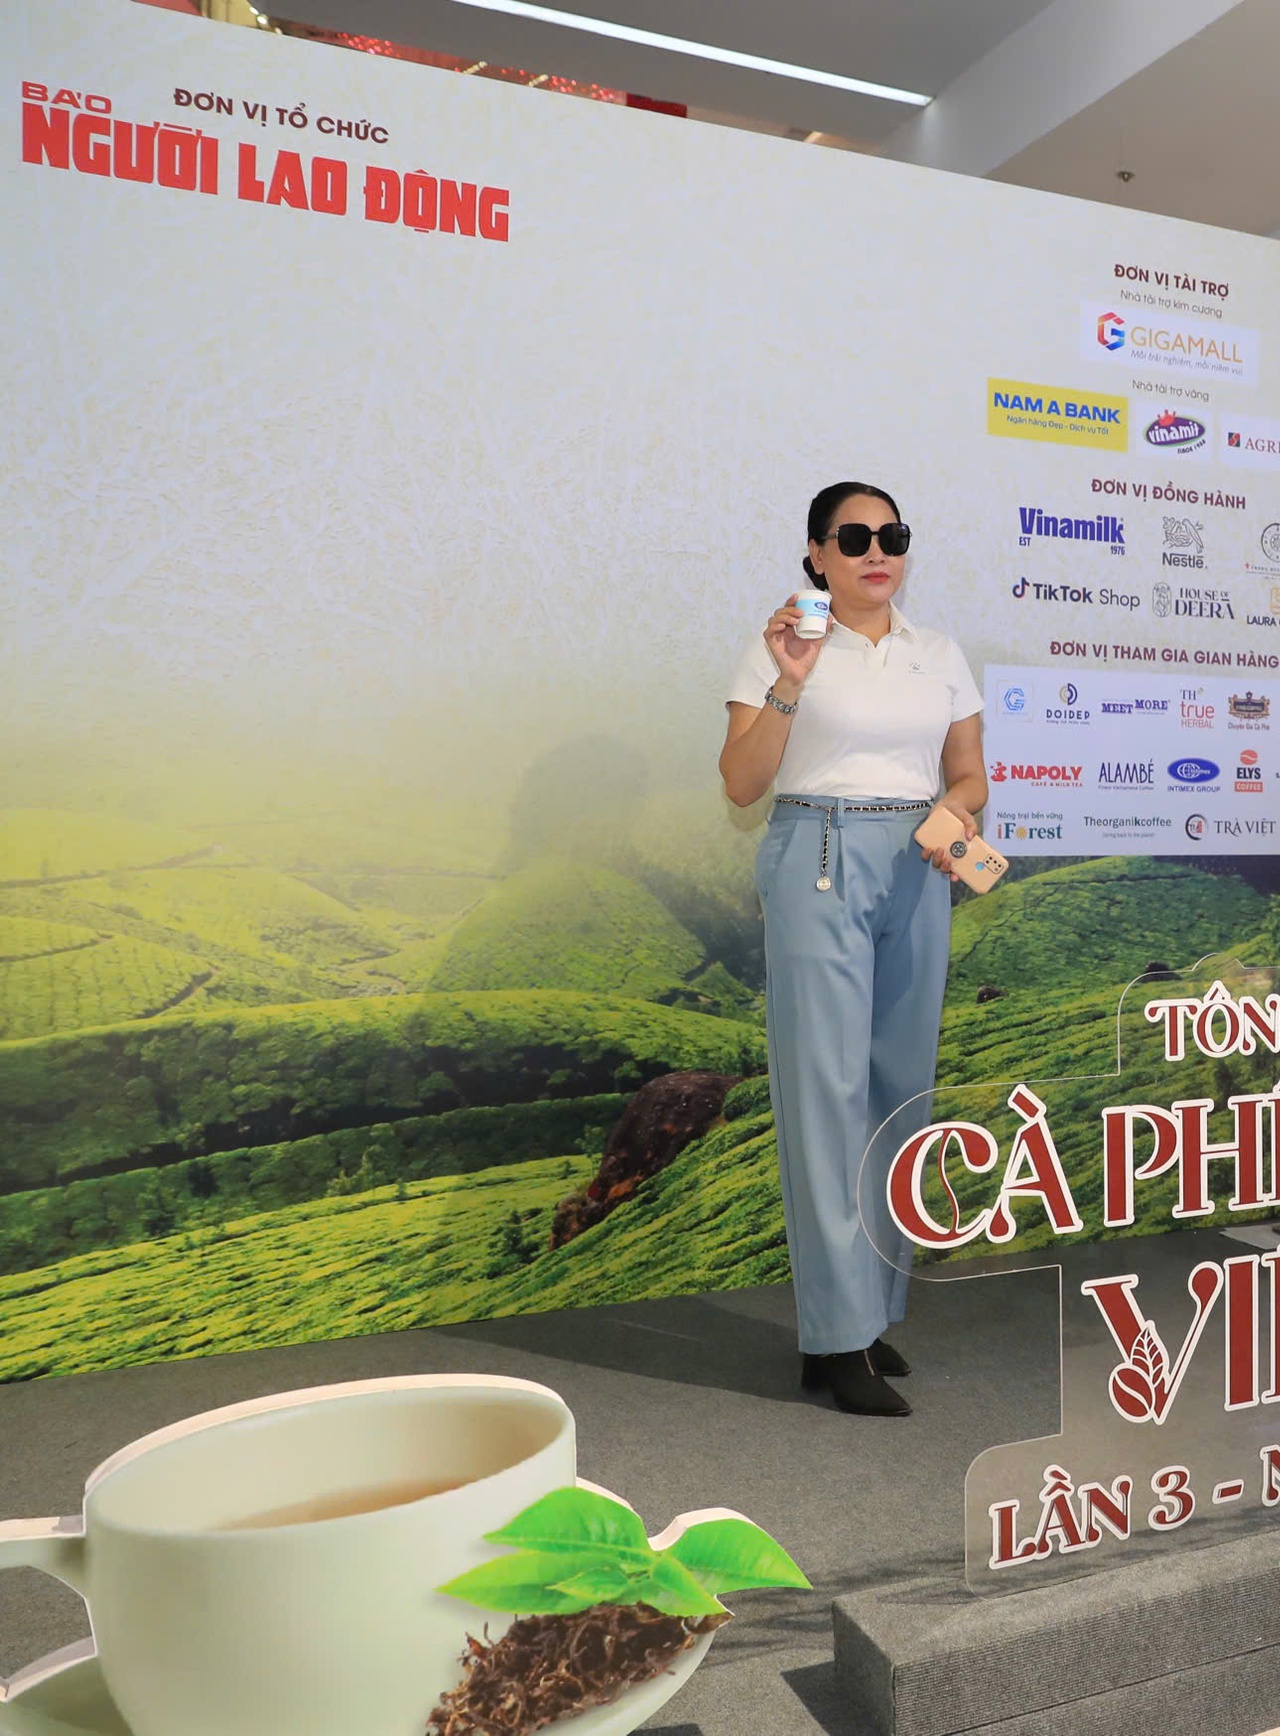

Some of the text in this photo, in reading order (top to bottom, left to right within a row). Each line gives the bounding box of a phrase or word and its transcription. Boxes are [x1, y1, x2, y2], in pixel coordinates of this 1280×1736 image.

[174, 87, 389, 144] ĐƠN VỊ TỔ CHỨC
[22, 102, 510, 242] NGƯỜI LAO ĐỘNG
[1114, 264, 1229, 301] ĐƠN VỊ TÀI TRỢ
[1120, 289, 1141, 301] Nhà
[1143, 295, 1156, 304] tài
[1158, 297, 1171, 308] trợ
[1173, 299, 1190, 311] kim
[1130, 325, 1244, 364] GIGAMALL
[1132, 379, 1210, 402] Nhà tài trợ vàng
[994, 392, 1121, 424] NAM A BANK
[1148, 421, 1200, 443] vinamit
[1091, 478, 1247, 510] ĐƠN VỊ ĐỒNG HÀNH
[1019, 506, 1126, 544] Vinamilk
[1019, 536, 1126, 556] EST 1976
[1032, 582, 1141, 611] TikTok Shop
[1180, 587, 1219, 601] HOUSE
[1175, 599, 1235, 620] DEERA
[1246, 615, 1277, 627] LAURA
[1050, 641, 1279, 669] ĐƠN VỊ THAM GIA GIAN HÀNG
[1180, 689, 1196, 700] TH
[1046, 709, 1090, 720] DOIDEP
[1101, 703, 1133, 714] MEET
[1135, 699, 1168, 710] MORE
[1180, 701, 1215, 719] true
[1181, 719, 1214, 729] HERBAL
[1010, 764, 1083, 780] NAPOLY
[1099, 758, 1154, 784] ALAMBÉ
[1236, 767, 1261, 780] ELYS
[1167, 785, 1221, 793] INTIMEX GROUP
[1084, 816, 1172, 829] Theorganikcoffee
[1213, 818, 1242, 837] TRÀ
[1244, 818, 1276, 836] VIỆT
[1145, 981, 1280, 1061] TÔN
[887, 1084, 1083, 1249] CÀ
[990, 1465, 1132, 1569] LẦN
[1149, 1466, 1195, 1531] 3
[1213, 1479, 1245, 1503] -
